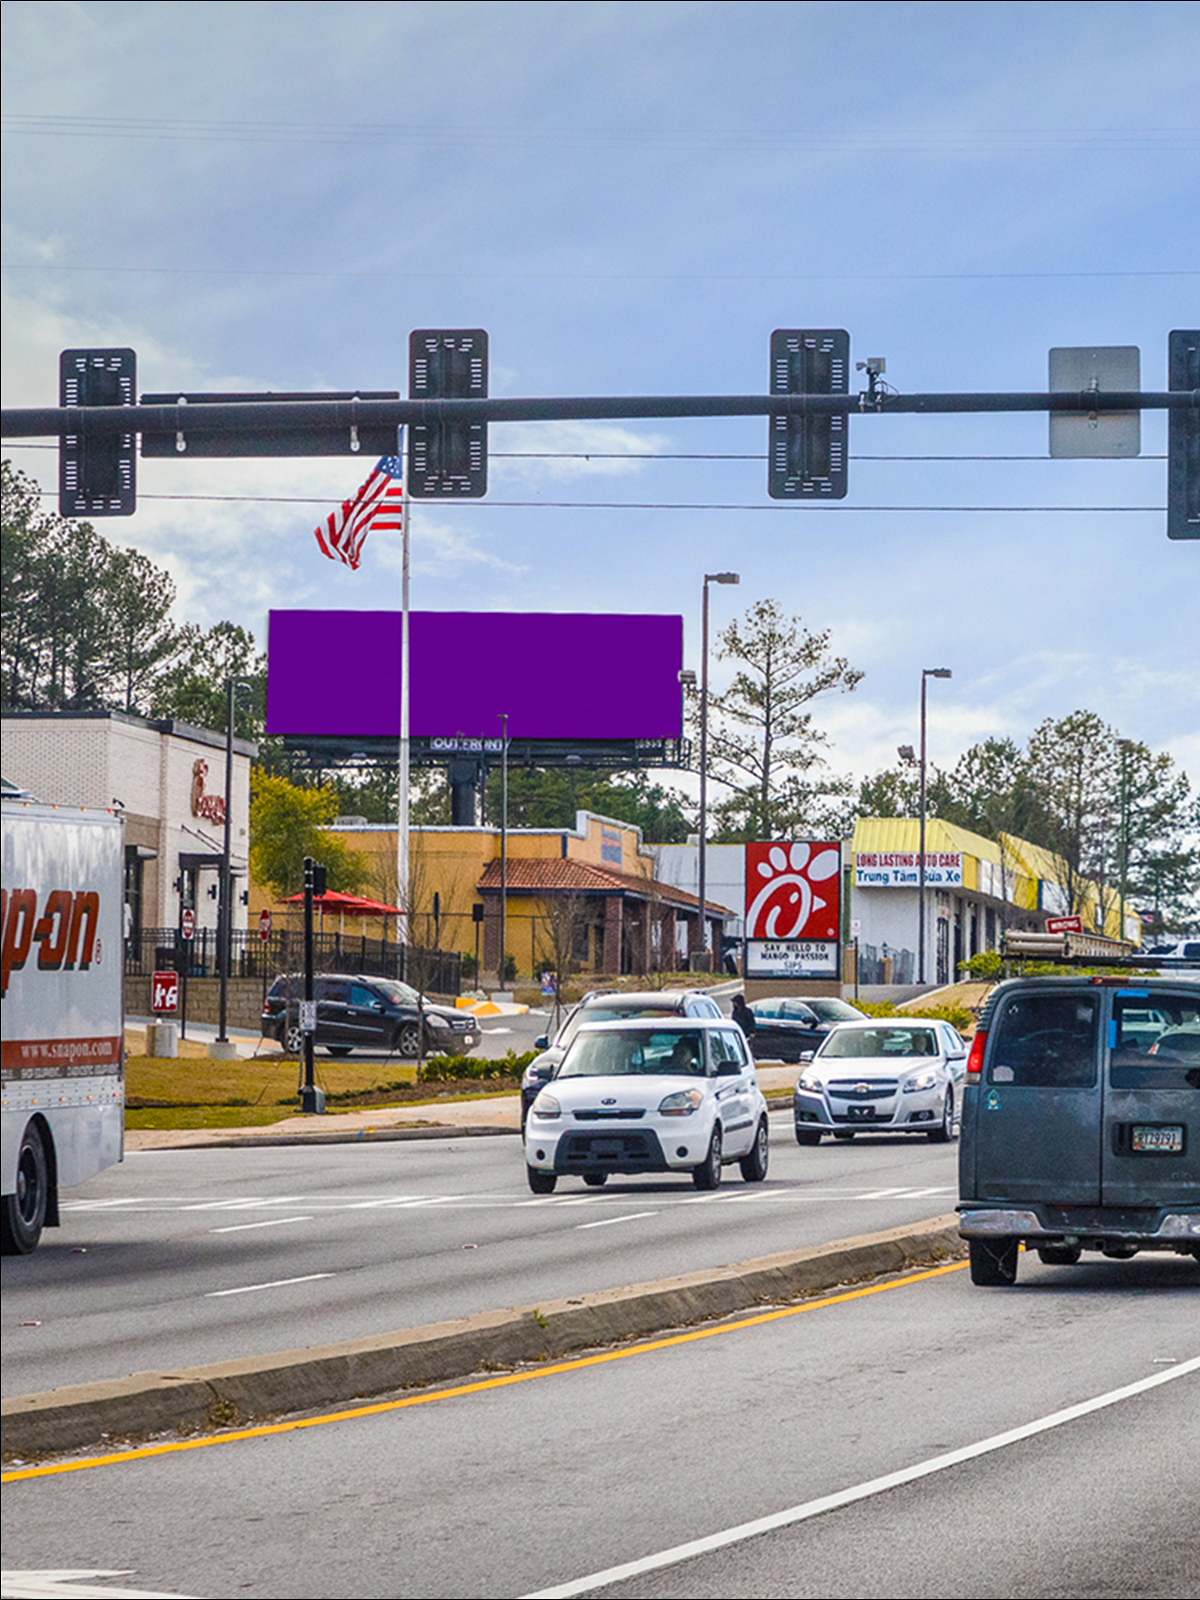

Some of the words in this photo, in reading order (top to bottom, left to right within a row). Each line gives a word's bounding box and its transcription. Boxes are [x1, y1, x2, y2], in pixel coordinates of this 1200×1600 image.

[856, 853, 877, 868] LONG
[879, 853, 914, 868] LASTING
[939, 853, 961, 868] CARE
[856, 870, 889, 884] Trung
[946, 870, 961, 882] Xe
[764, 943, 780, 952] SAY
[786, 943, 811, 952] HELLO
[815, 943, 826, 952] TO
[761, 952, 789, 961] MANGO
[795, 952, 829, 961] PASSION
[21, 1042, 112, 1063] www.snapon.com
